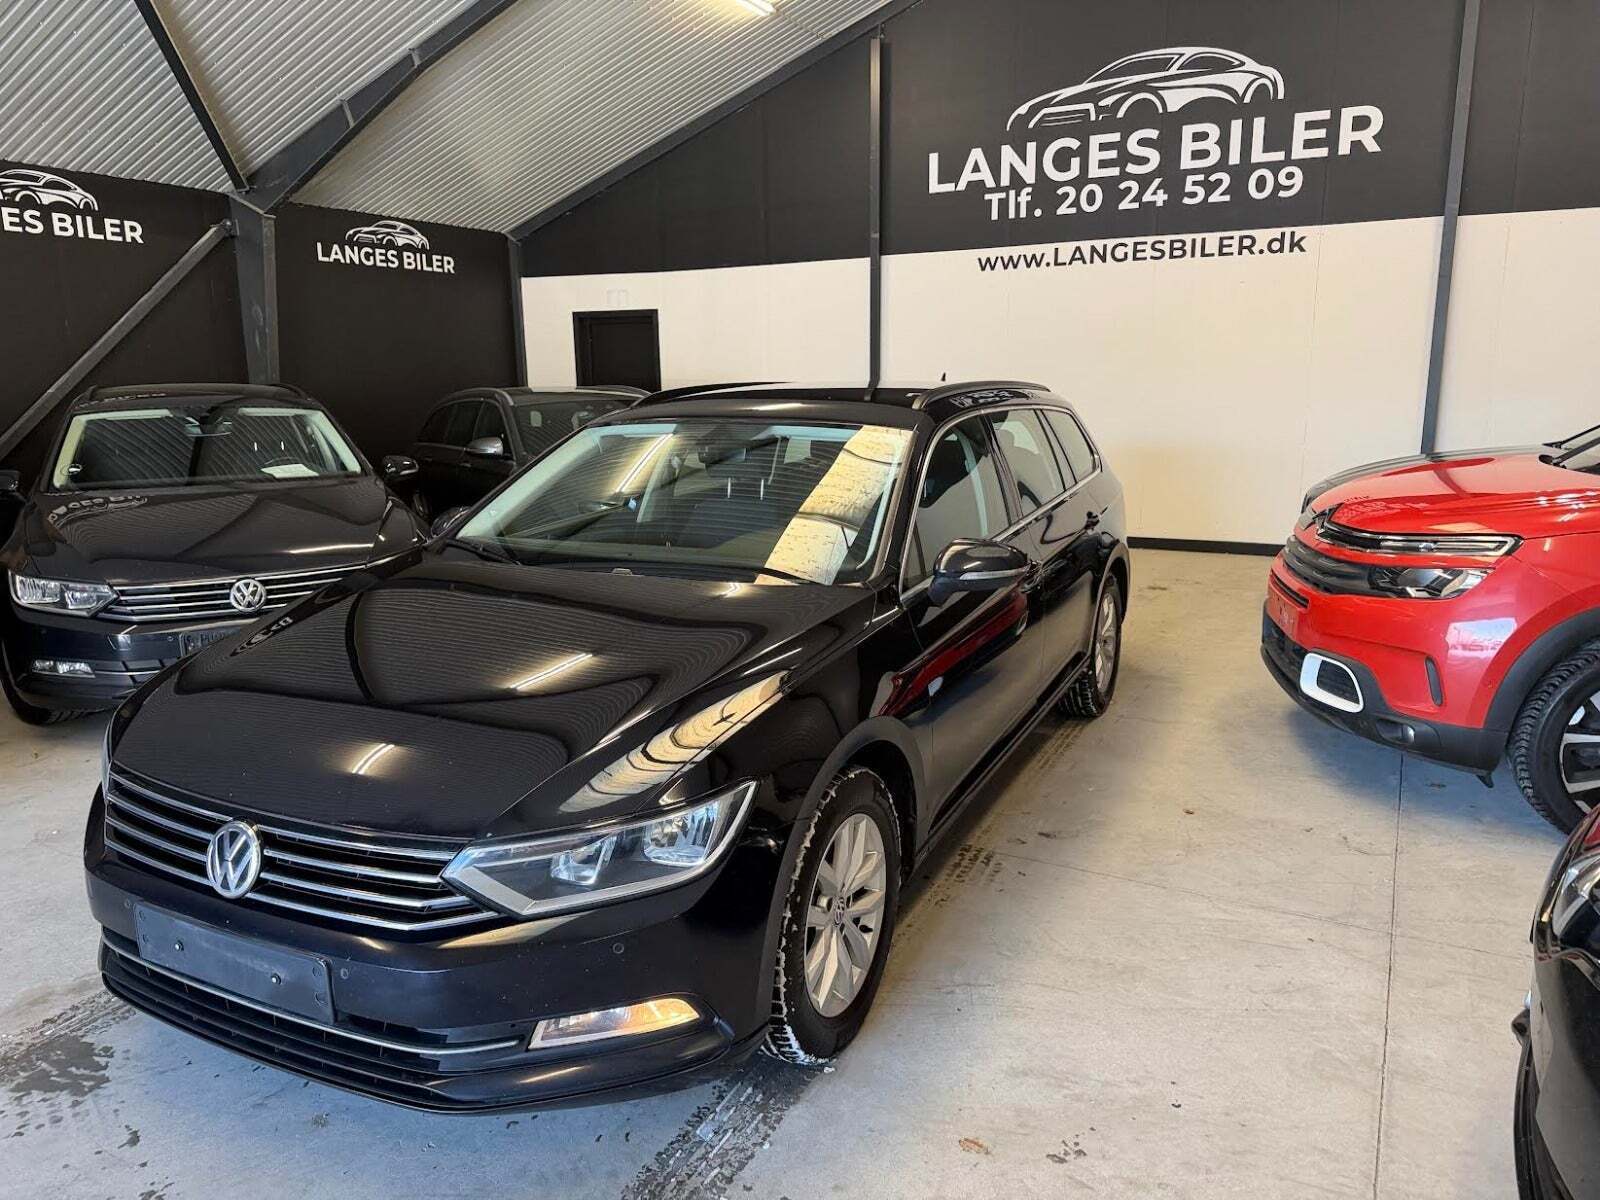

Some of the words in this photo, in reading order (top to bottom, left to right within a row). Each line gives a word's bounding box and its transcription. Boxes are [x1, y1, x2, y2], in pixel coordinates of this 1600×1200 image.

[928, 127, 1162, 194] LANGES
[1179, 104, 1384, 170] BILER
[984, 186, 1043, 221] Tlf.
[1056, 184, 1104, 216] 20
[1117, 178, 1169, 211] 24
[1181, 173, 1231, 206] 52
[1247, 165, 1304, 200] 09
[52, 212, 145, 244] BILER
[316, 241, 400, 269] LANGES
[402, 251, 455, 274] BILER
[977, 231, 1307, 272] www.LANGESBILER.dk
